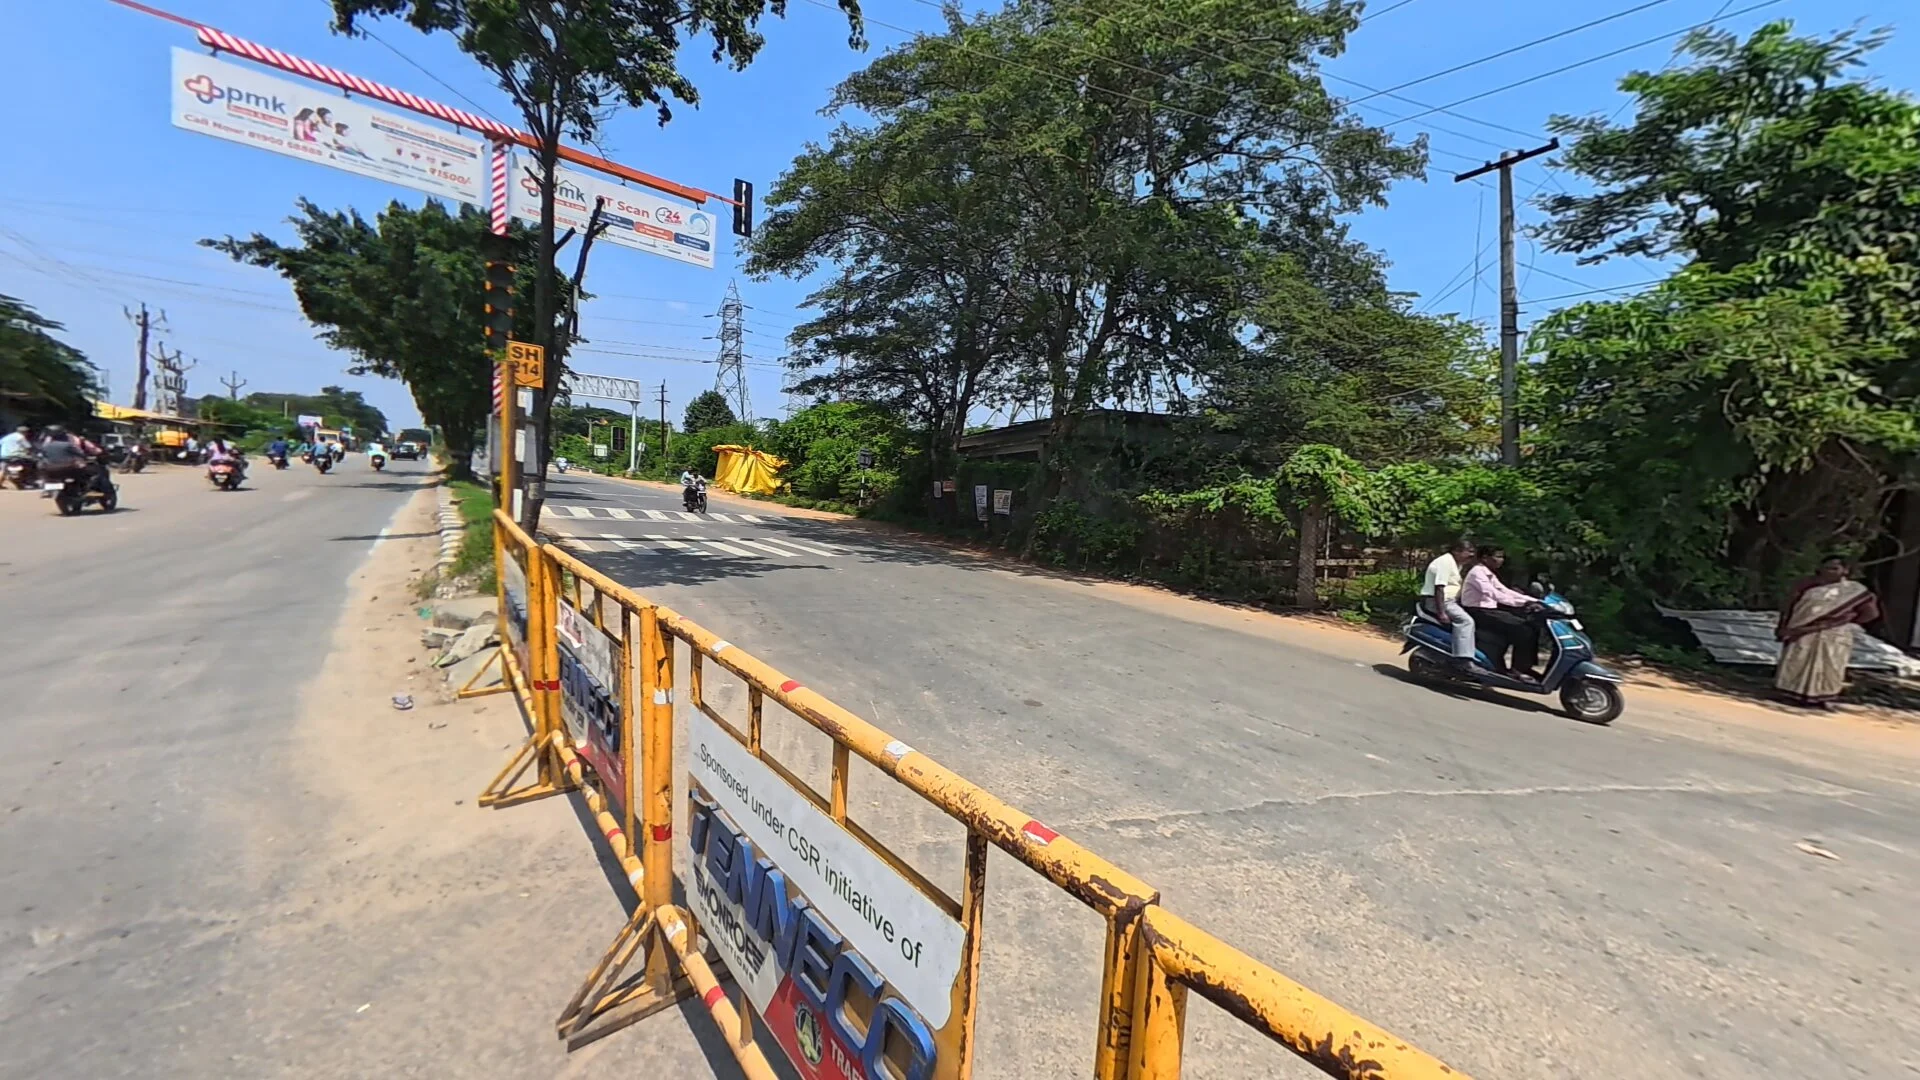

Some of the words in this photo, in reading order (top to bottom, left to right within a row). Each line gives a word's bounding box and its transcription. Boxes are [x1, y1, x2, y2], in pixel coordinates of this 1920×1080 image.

[617, 201, 649, 218] Scan
[665, 209, 681, 220] 24
[512, 346, 539, 361] SH
[700, 743, 748, 804] Sponsored
[752, 795, 785, 838] under
[788, 827, 821, 875] CSR
[825, 859, 894, 943] initiative
[901, 937, 923, 968] of
[689, 788, 937, 1080] TENNECO
[694, 863, 765, 975] MONROE
